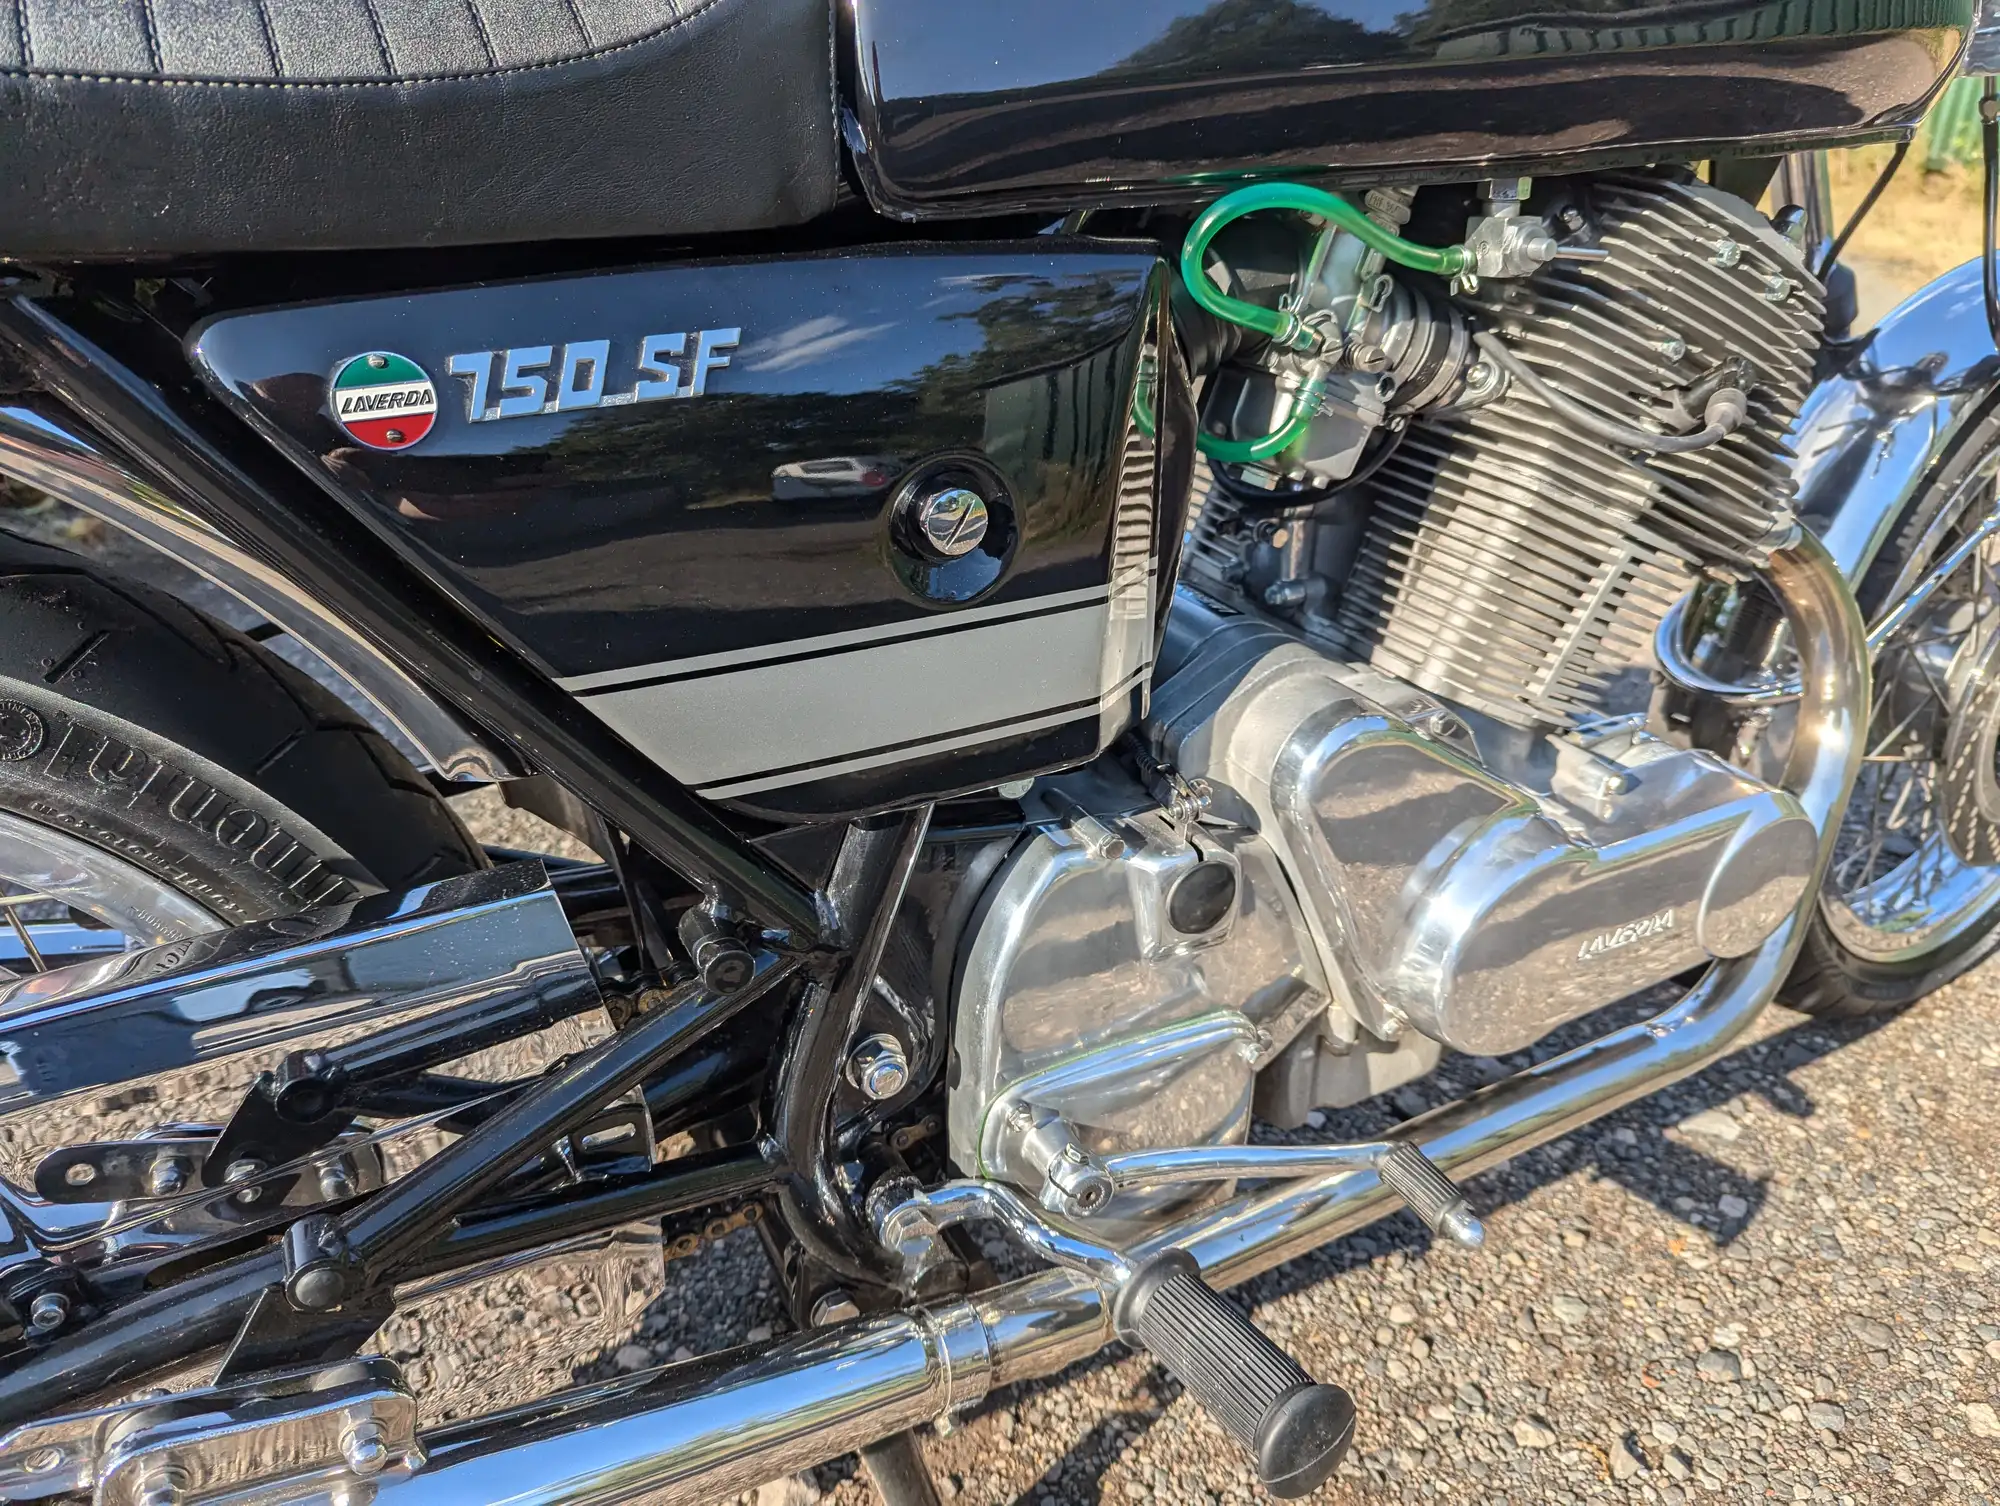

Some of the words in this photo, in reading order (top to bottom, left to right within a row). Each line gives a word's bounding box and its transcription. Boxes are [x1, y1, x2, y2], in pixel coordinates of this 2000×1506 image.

[340, 388, 435, 415] LAVERDA
[448, 339, 610, 424] 750
[636, 327, 742, 401] SF
[44, 720, 360, 912] tinental
[1577, 908, 1674, 962] LAVERDA
